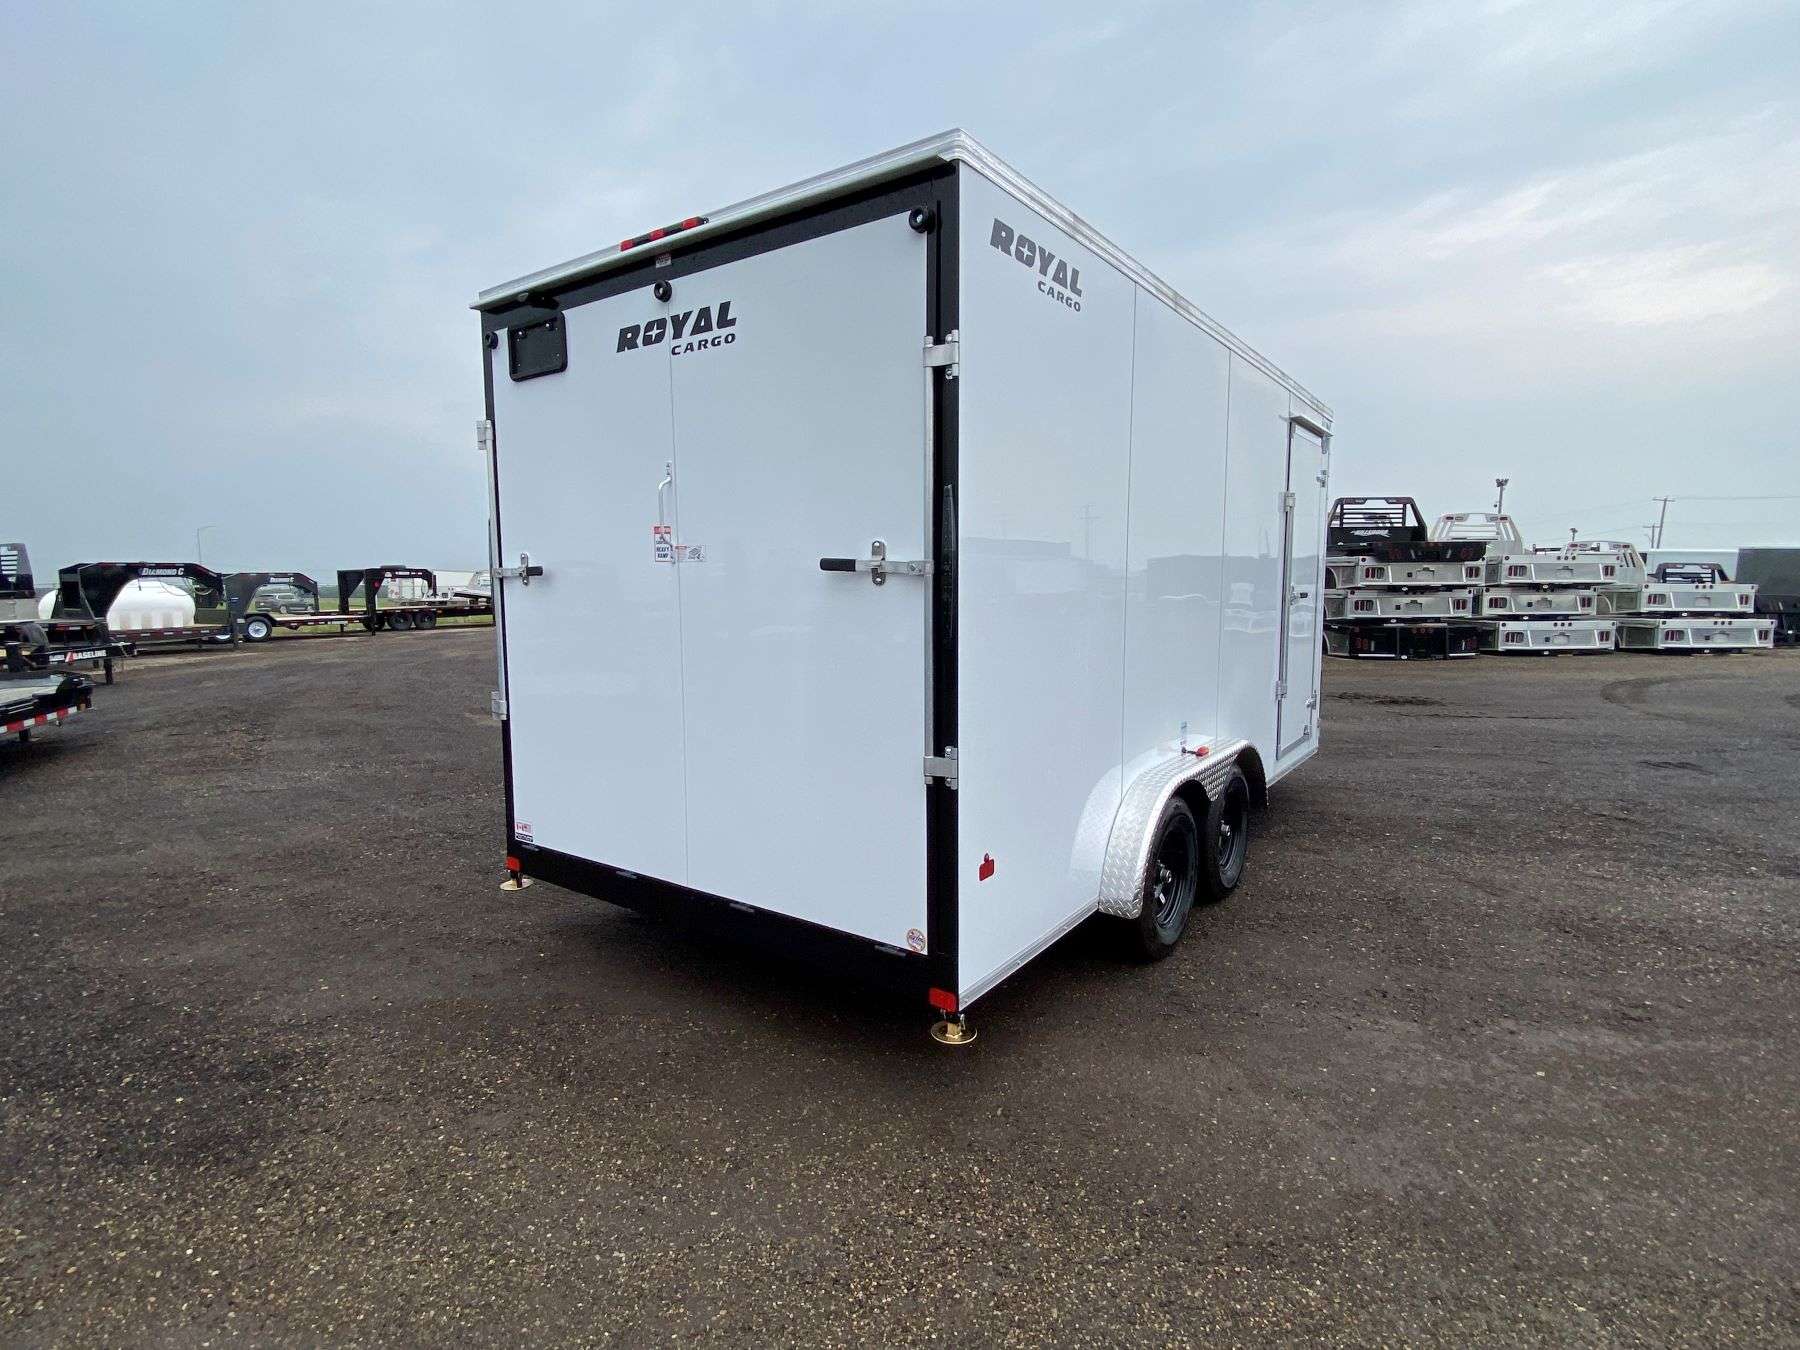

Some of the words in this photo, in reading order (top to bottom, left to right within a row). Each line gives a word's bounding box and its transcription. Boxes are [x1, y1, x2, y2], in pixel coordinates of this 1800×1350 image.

[990, 218, 1082, 298] ROYAL
[1037, 280, 1081, 312] CARGO
[616, 300, 737, 353] ROYAL
[671, 333, 736, 356] CARGO
[141, 567, 177, 576] DIAMOND
[177, 567, 185, 576] C
